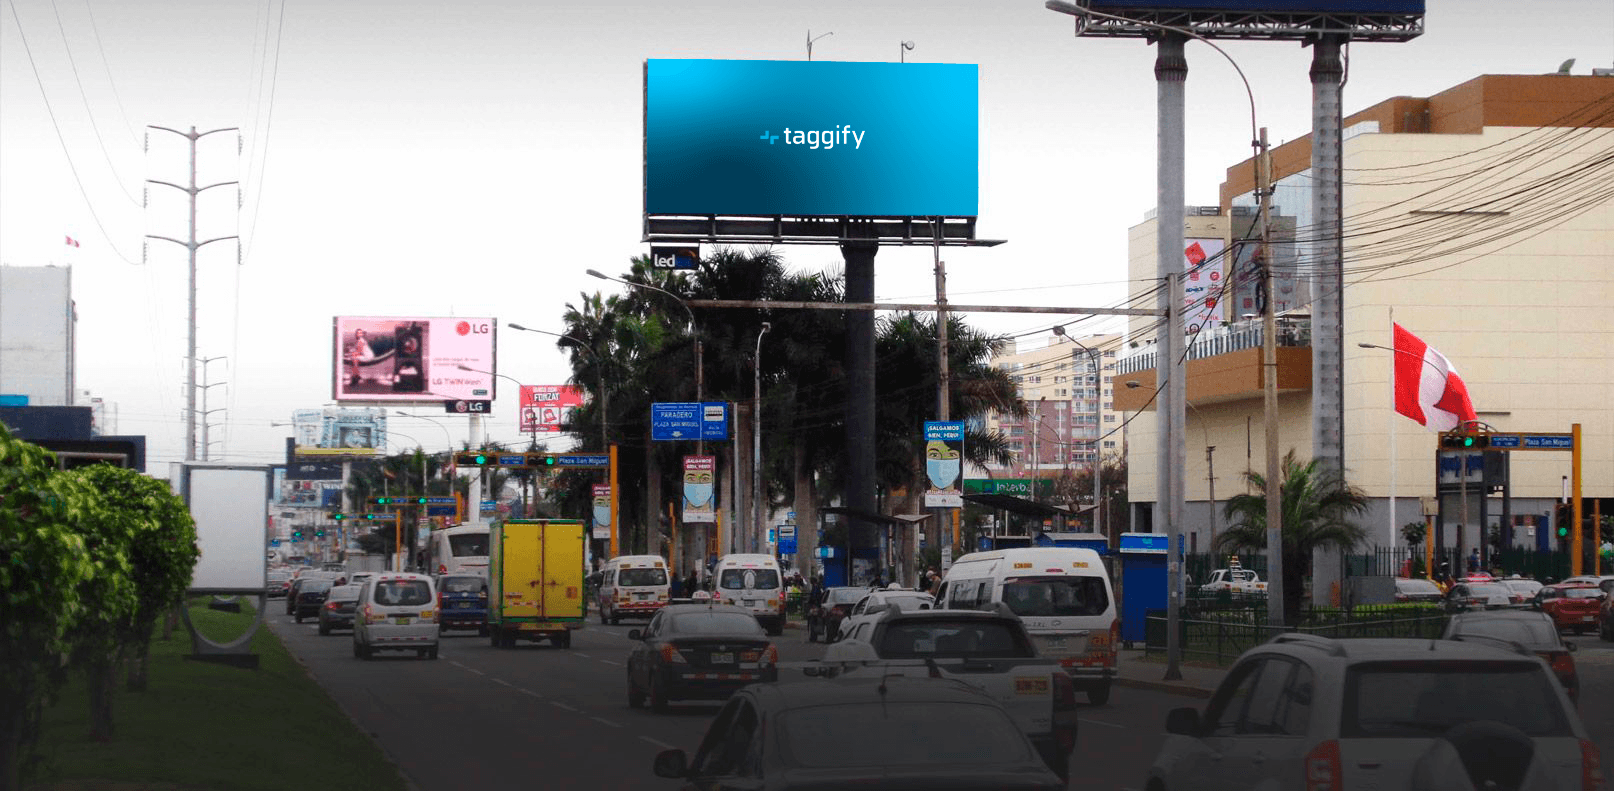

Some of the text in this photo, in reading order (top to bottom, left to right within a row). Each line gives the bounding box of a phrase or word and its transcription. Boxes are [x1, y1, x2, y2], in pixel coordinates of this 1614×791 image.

[783, 125, 866, 150] taggify
[472, 323, 489, 334] LG
[468, 402, 483, 411] LG
[1525, 438, 1540, 446] Plaza
[1541, 438, 1553, 446] San
[1553, 438, 1571, 447] Miguel
[559, 456, 608, 466] Plaza San Miguel
